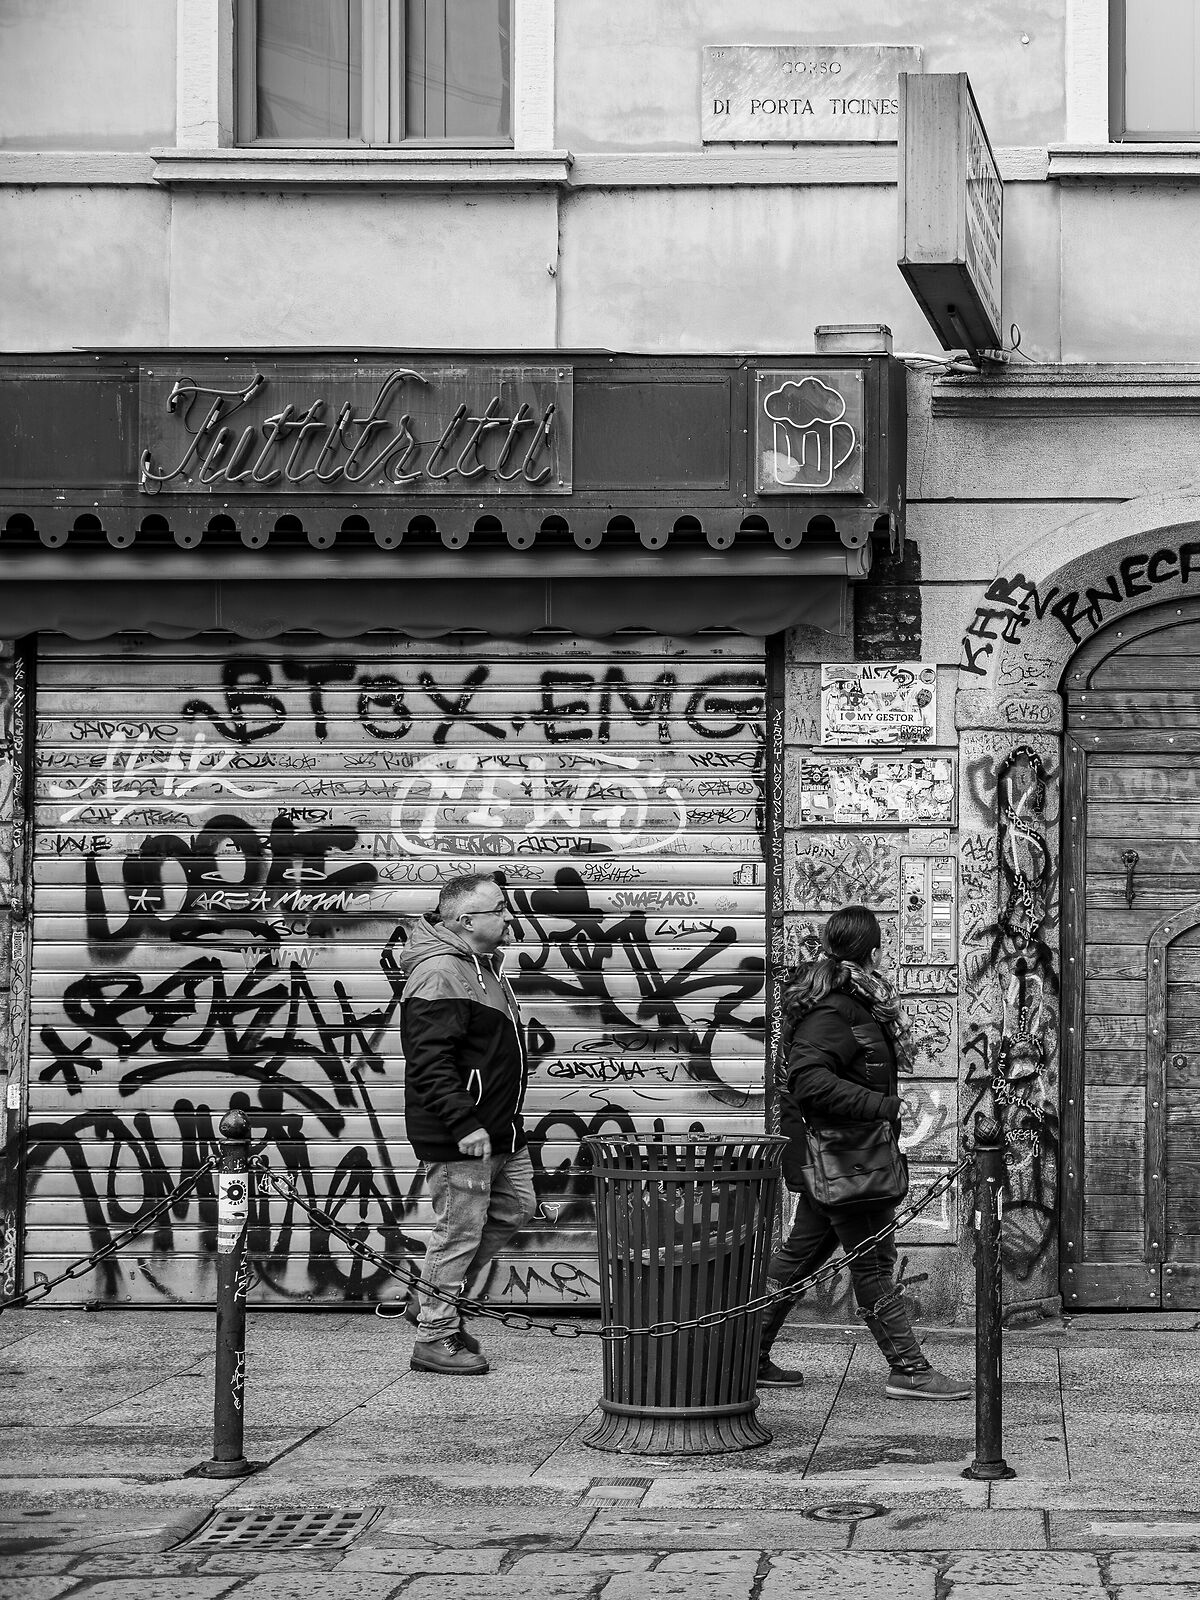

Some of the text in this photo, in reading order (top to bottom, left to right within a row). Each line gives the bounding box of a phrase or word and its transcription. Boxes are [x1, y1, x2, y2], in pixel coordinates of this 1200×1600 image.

[781, 61, 841, 75] CORSO
[713, 99, 899, 115] DI PORTA TICINES
[857, 713, 873, 721] MY
[876, 713, 914, 721] GESTOR
